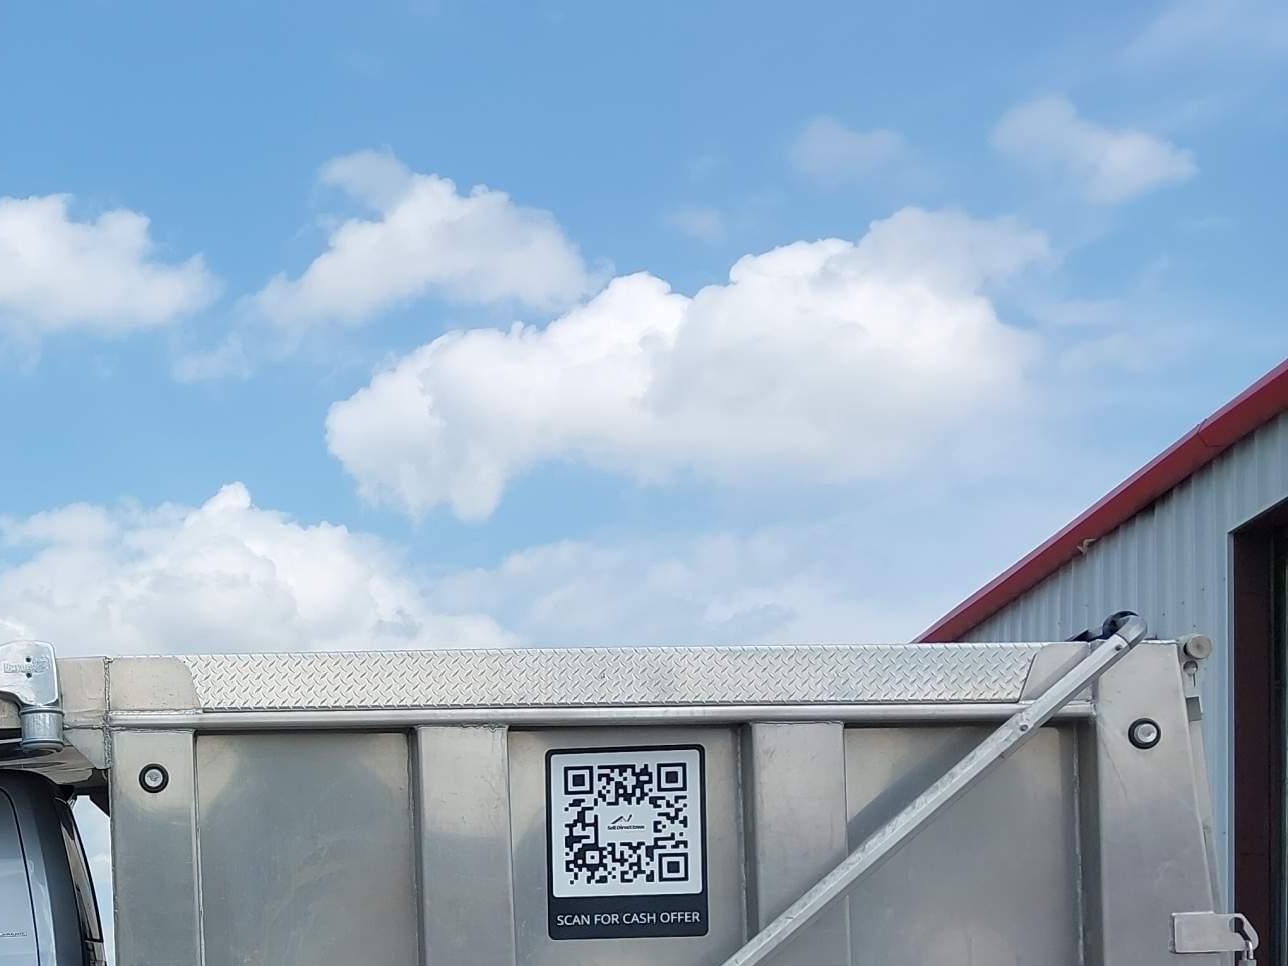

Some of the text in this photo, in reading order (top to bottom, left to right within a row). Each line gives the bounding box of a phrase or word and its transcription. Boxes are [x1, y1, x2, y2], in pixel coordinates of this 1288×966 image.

[556, 912, 701, 926] SCAN FOR CASH OFFER
